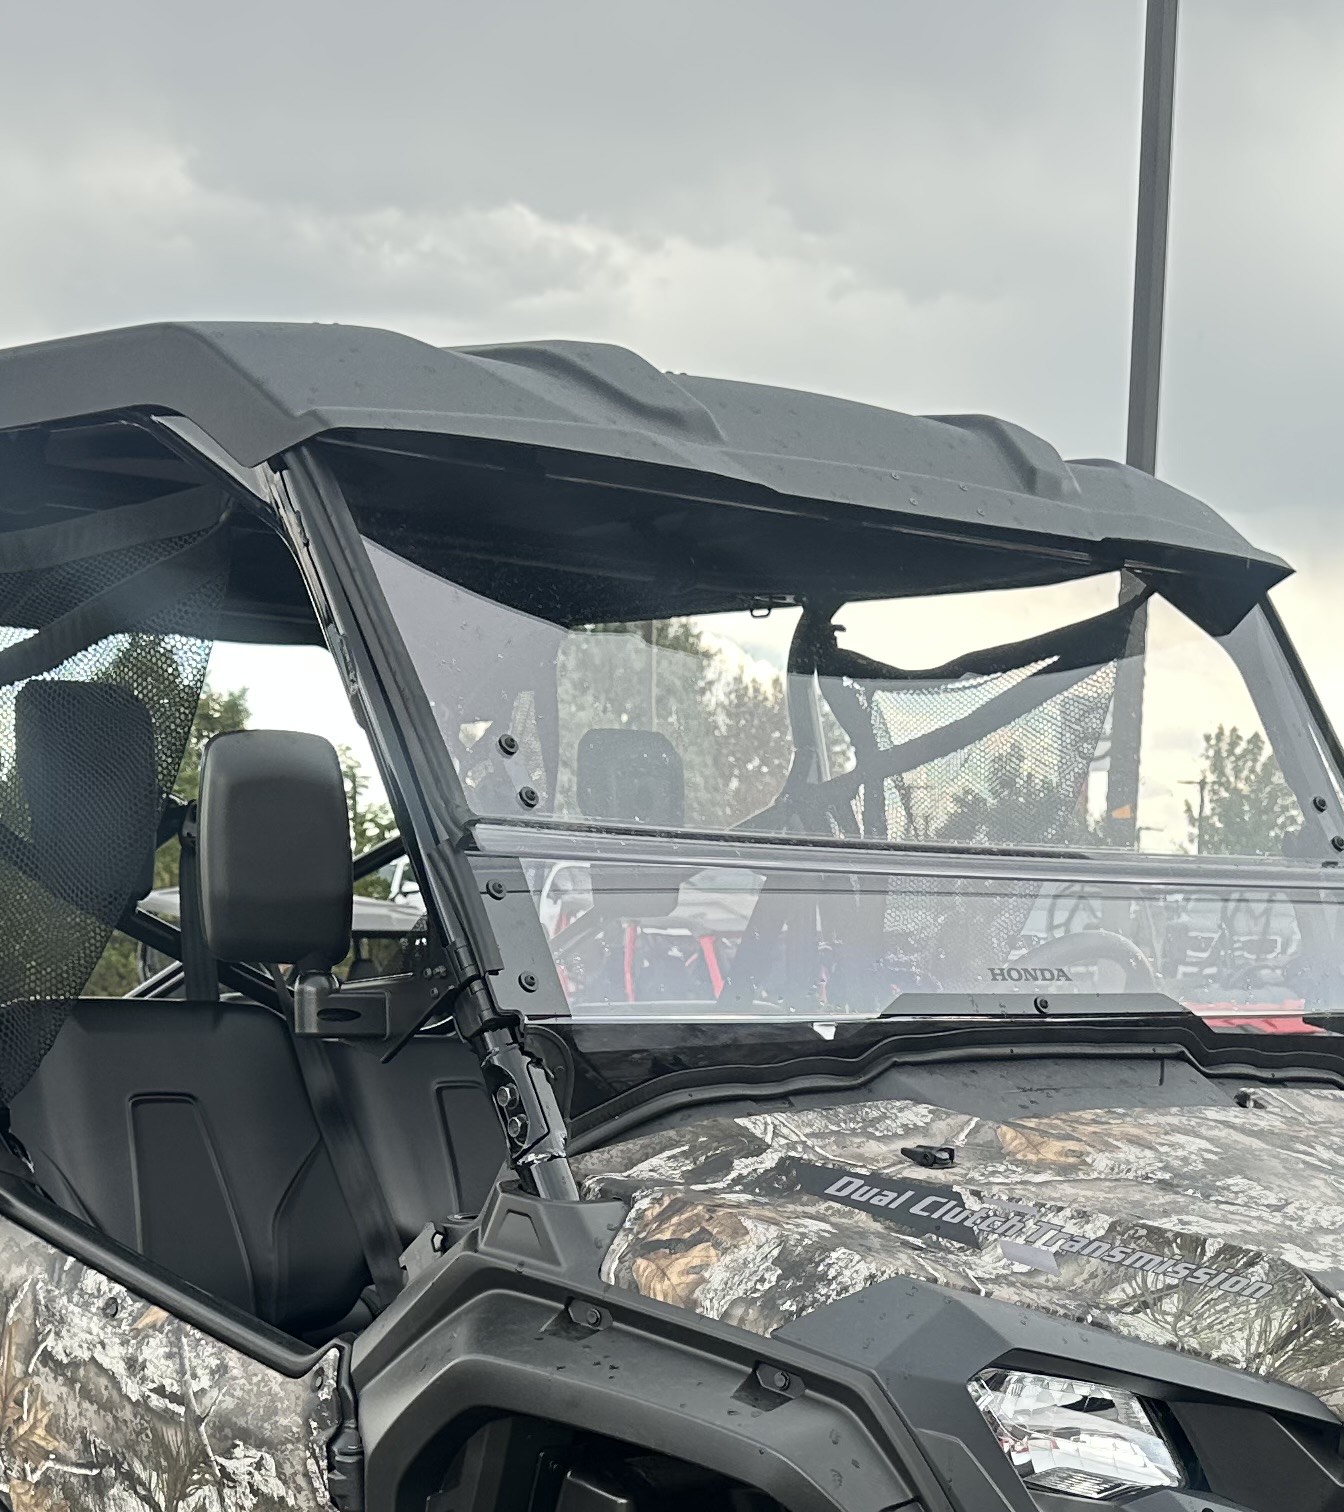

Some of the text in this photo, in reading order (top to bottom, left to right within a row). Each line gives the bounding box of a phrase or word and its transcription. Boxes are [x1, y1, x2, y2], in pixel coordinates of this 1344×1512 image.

[987, 967, 1073, 982] HONDA
[823, 1175, 1275, 1299] Dual Clutch Transmission
